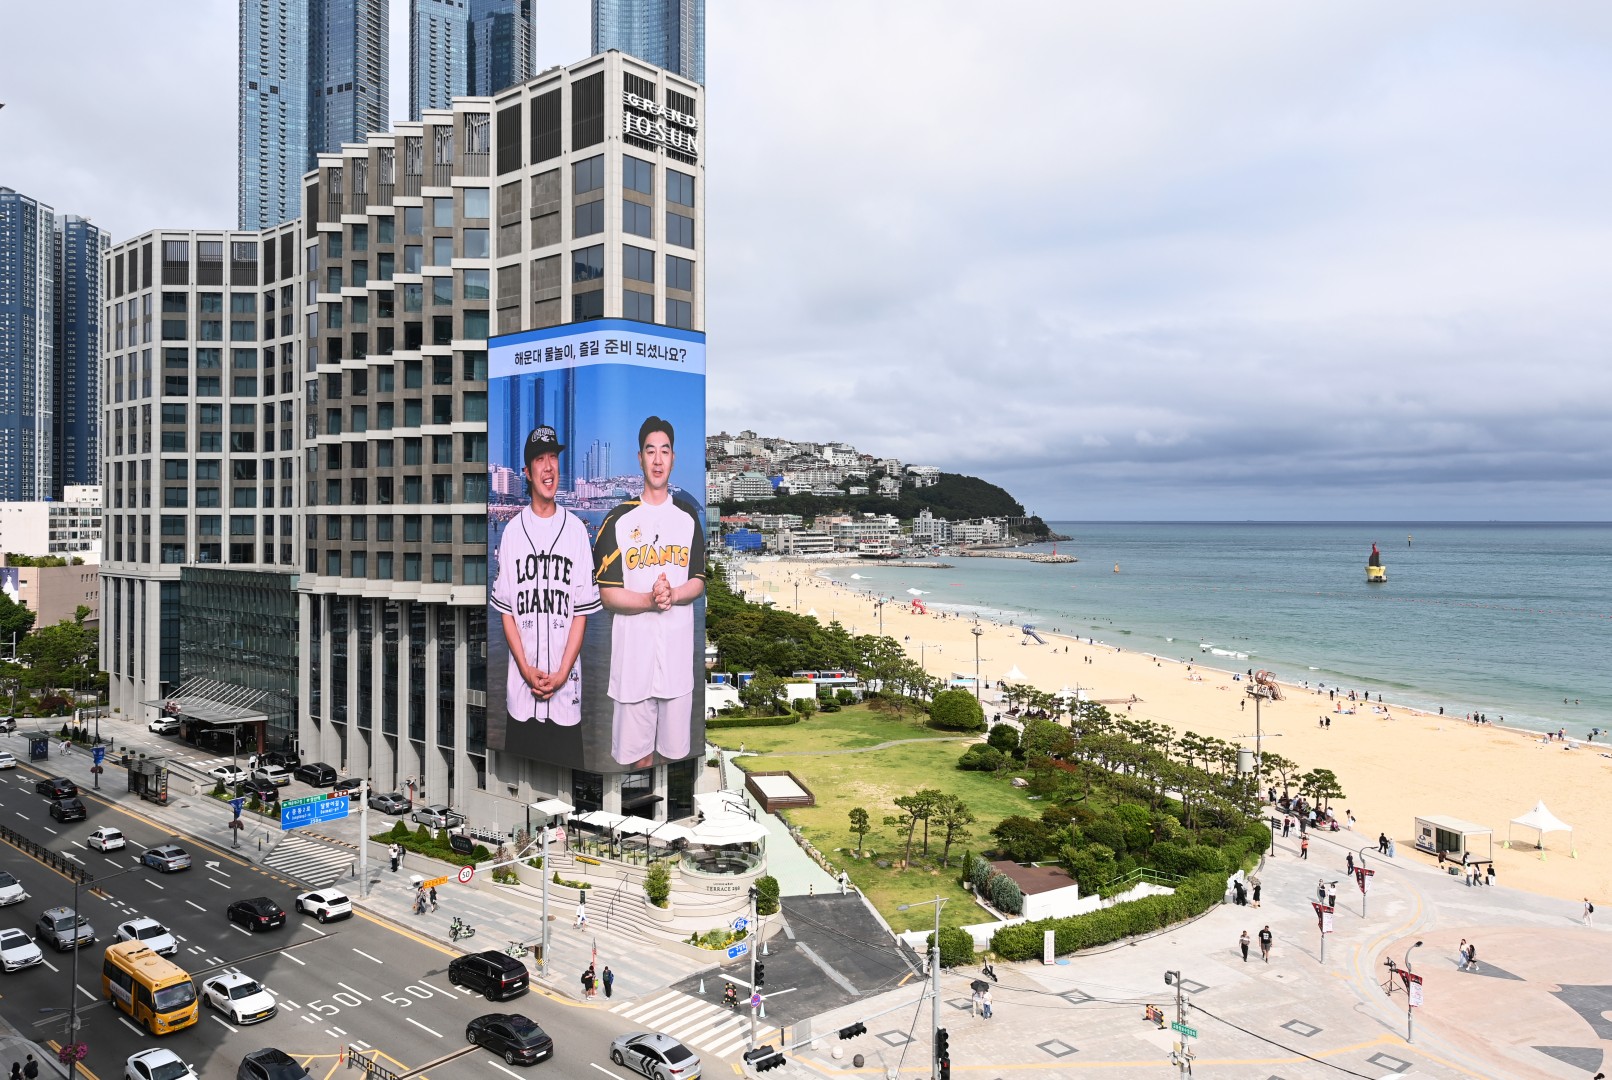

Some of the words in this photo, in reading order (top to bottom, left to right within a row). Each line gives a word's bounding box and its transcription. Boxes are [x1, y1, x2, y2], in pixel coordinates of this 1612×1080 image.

[627, 93, 697, 128] GRAND
[625, 111, 699, 154] JOSUN
[514, 348, 542, 366] 해운대
[544, 343, 576, 361] 물놀이,
[579, 340, 600, 357] 즐길
[604, 339, 632, 356] 준비
[636, 342, 687, 363] 되셨나요?
[515, 551, 574, 586] LOTTE
[516, 588, 570, 619] GIANTS
[462, 870, 470, 879] 50
[307, 992, 363, 1016] 50
[381, 985, 434, 1008] 50
